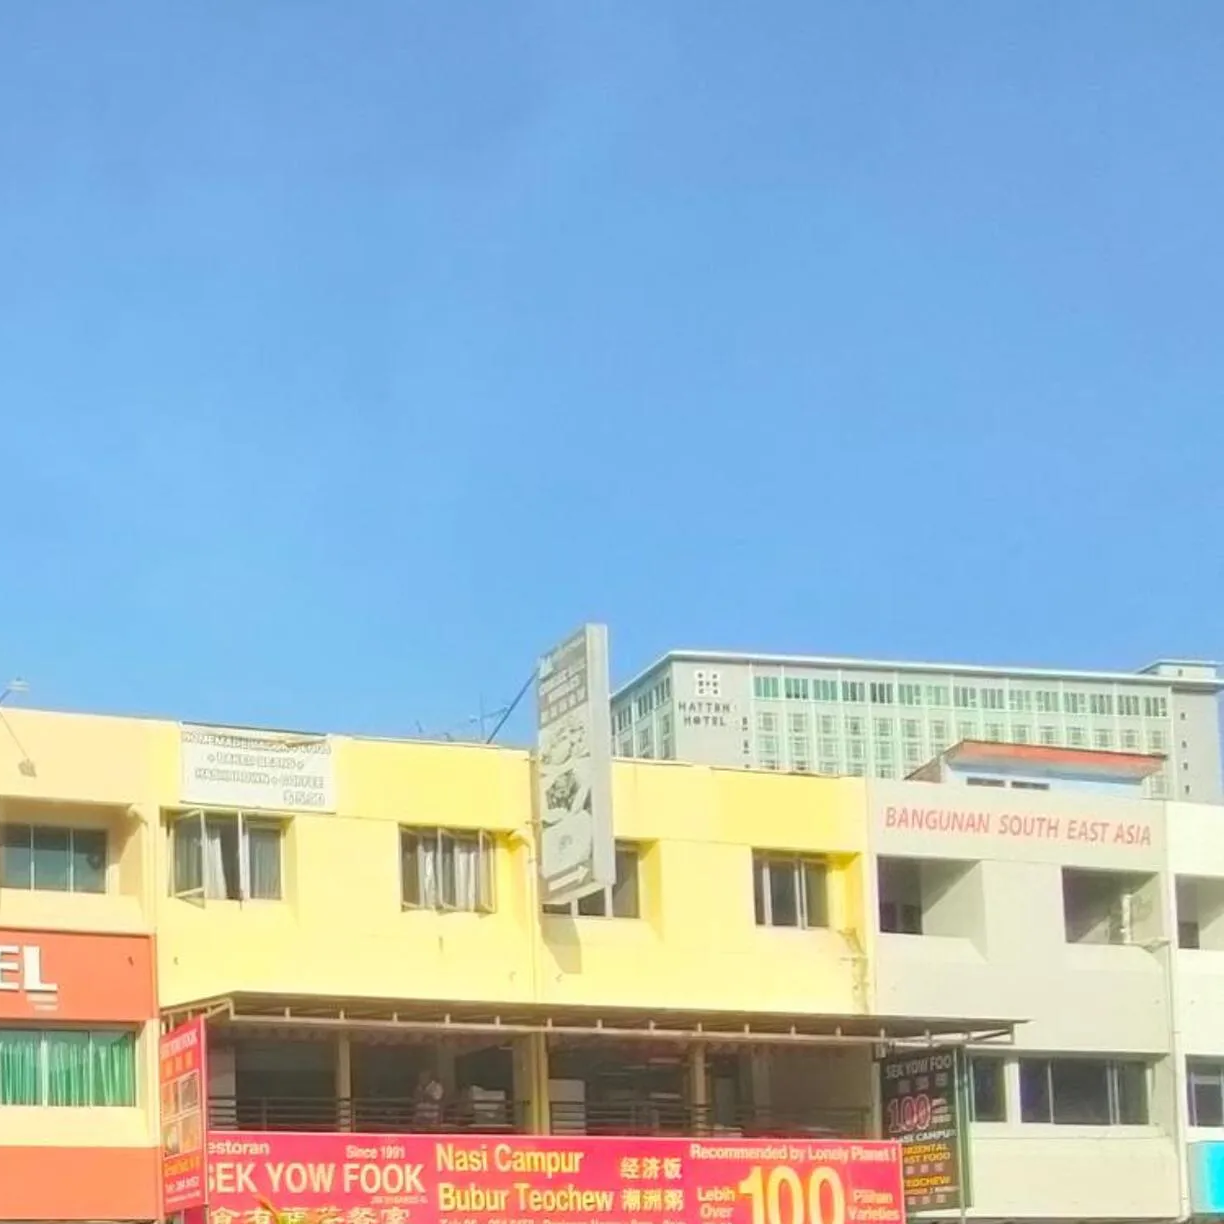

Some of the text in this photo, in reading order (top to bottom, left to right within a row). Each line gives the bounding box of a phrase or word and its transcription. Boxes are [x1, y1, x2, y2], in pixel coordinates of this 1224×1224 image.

[683, 715, 726, 727] HOTEL
[885, 807, 1151, 845] BANGUNAN SOUTH EAST ASIA
[888, 1094, 931, 1133] 100
[208, 1141, 270, 1155] estoran
[346, 1144, 378, 1160] Since
[436, 1143, 584, 1179] Nasi Campur
[690, 1144, 788, 1160] Recommended
[265, 1163, 336, 1194] YOW
[343, 1163, 426, 1195] FOOK
[438, 1183, 613, 1212] Bubur Teochew
[700, 1203, 734, 1219] Over
